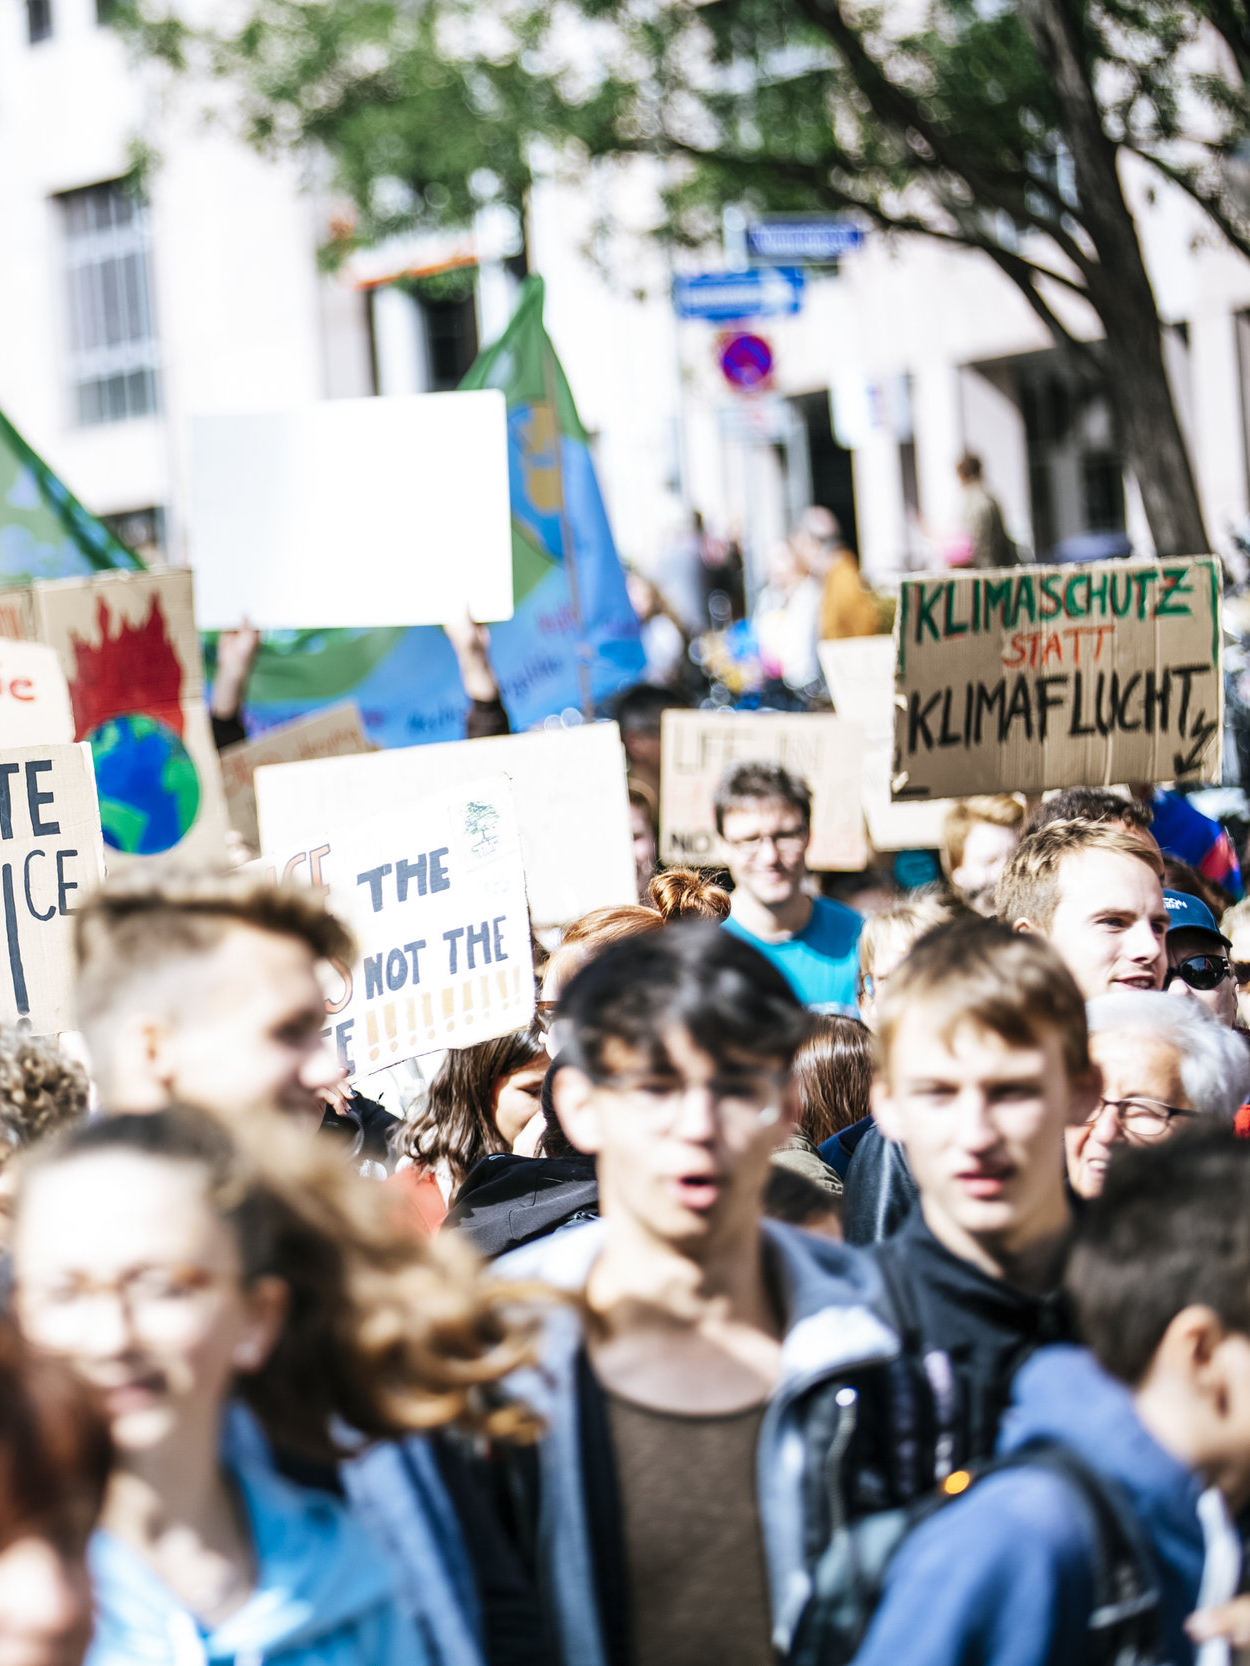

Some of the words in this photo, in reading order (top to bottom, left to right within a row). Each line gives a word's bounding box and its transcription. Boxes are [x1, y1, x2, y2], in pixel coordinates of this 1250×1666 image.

[914, 567, 1194, 644] KLIMASCHUTZ
[1001, 625, 1116, 669] STATT
[908, 663, 1211, 755] KLIMAFLUCHT
[356, 847, 450, 912] THE
[363, 939, 427, 1000] NOT
[442, 915, 508, 975] THE
